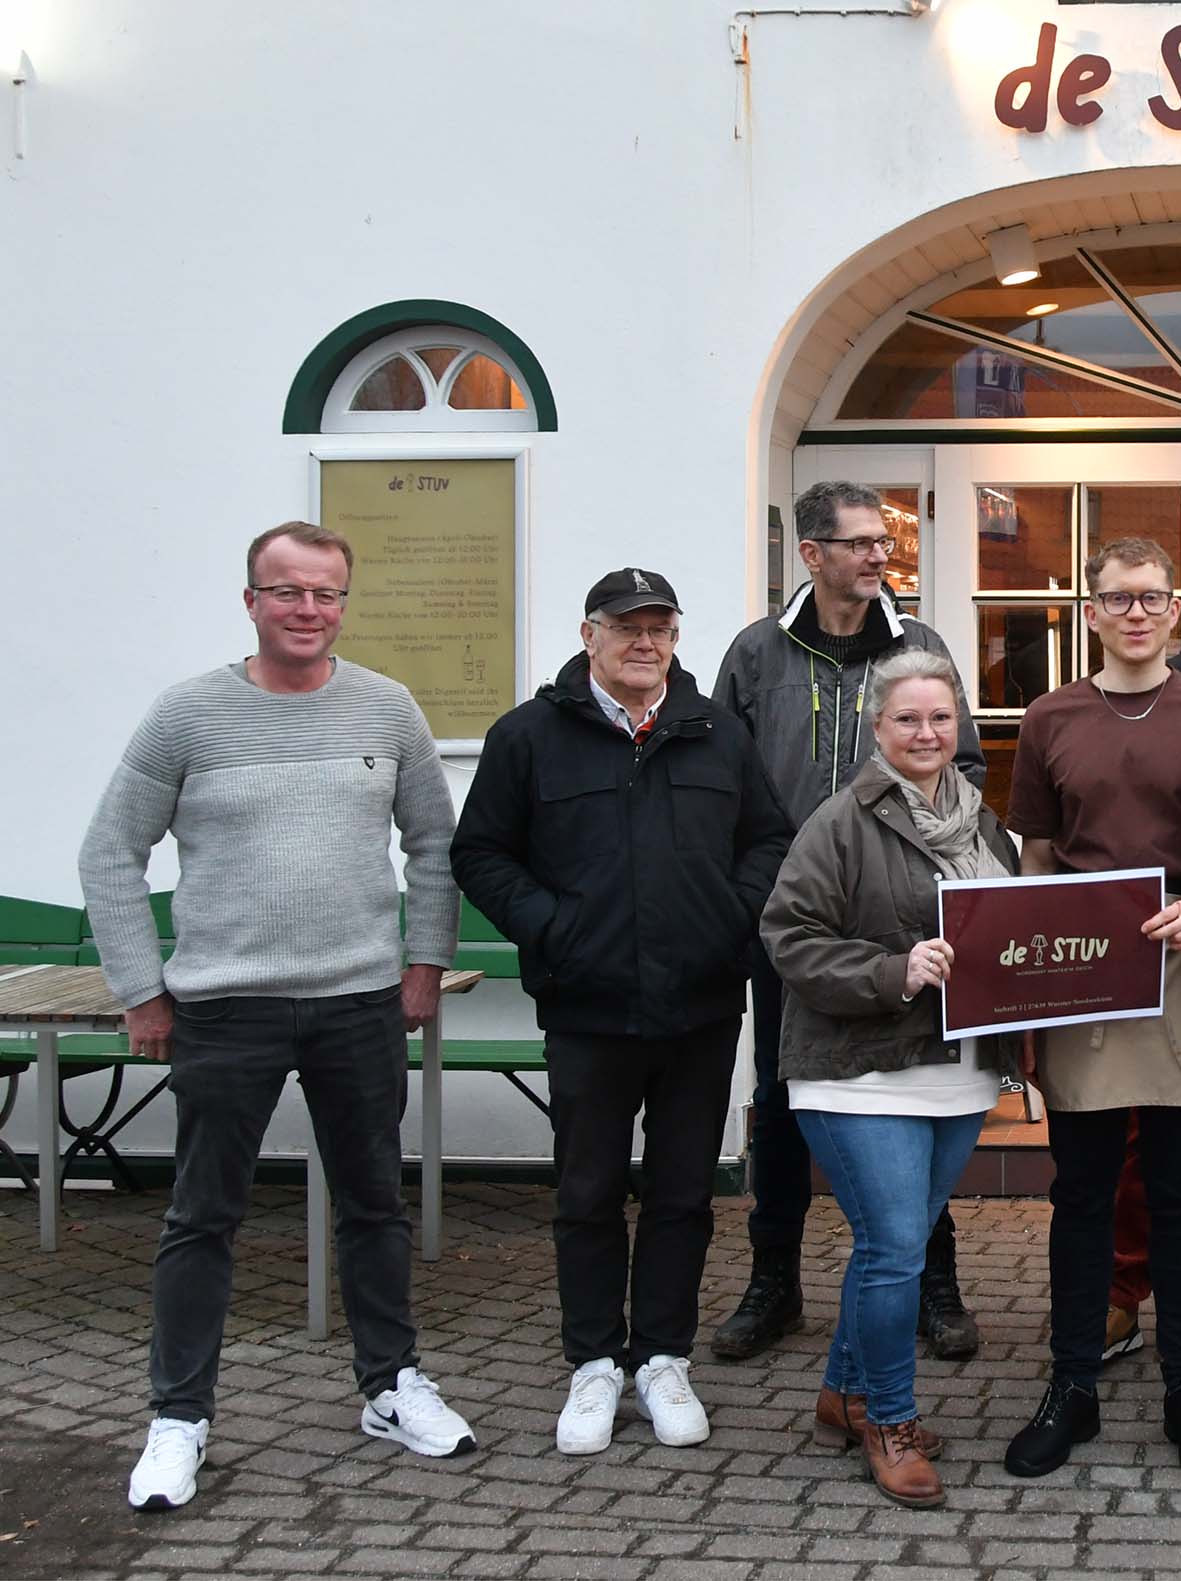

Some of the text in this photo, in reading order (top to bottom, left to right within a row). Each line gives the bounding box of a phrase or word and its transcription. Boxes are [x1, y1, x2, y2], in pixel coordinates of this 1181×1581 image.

[994, 22, 1112, 133] de
[388, 475, 450, 491] de STUV
[999, 936, 1110, 966] de STUV
